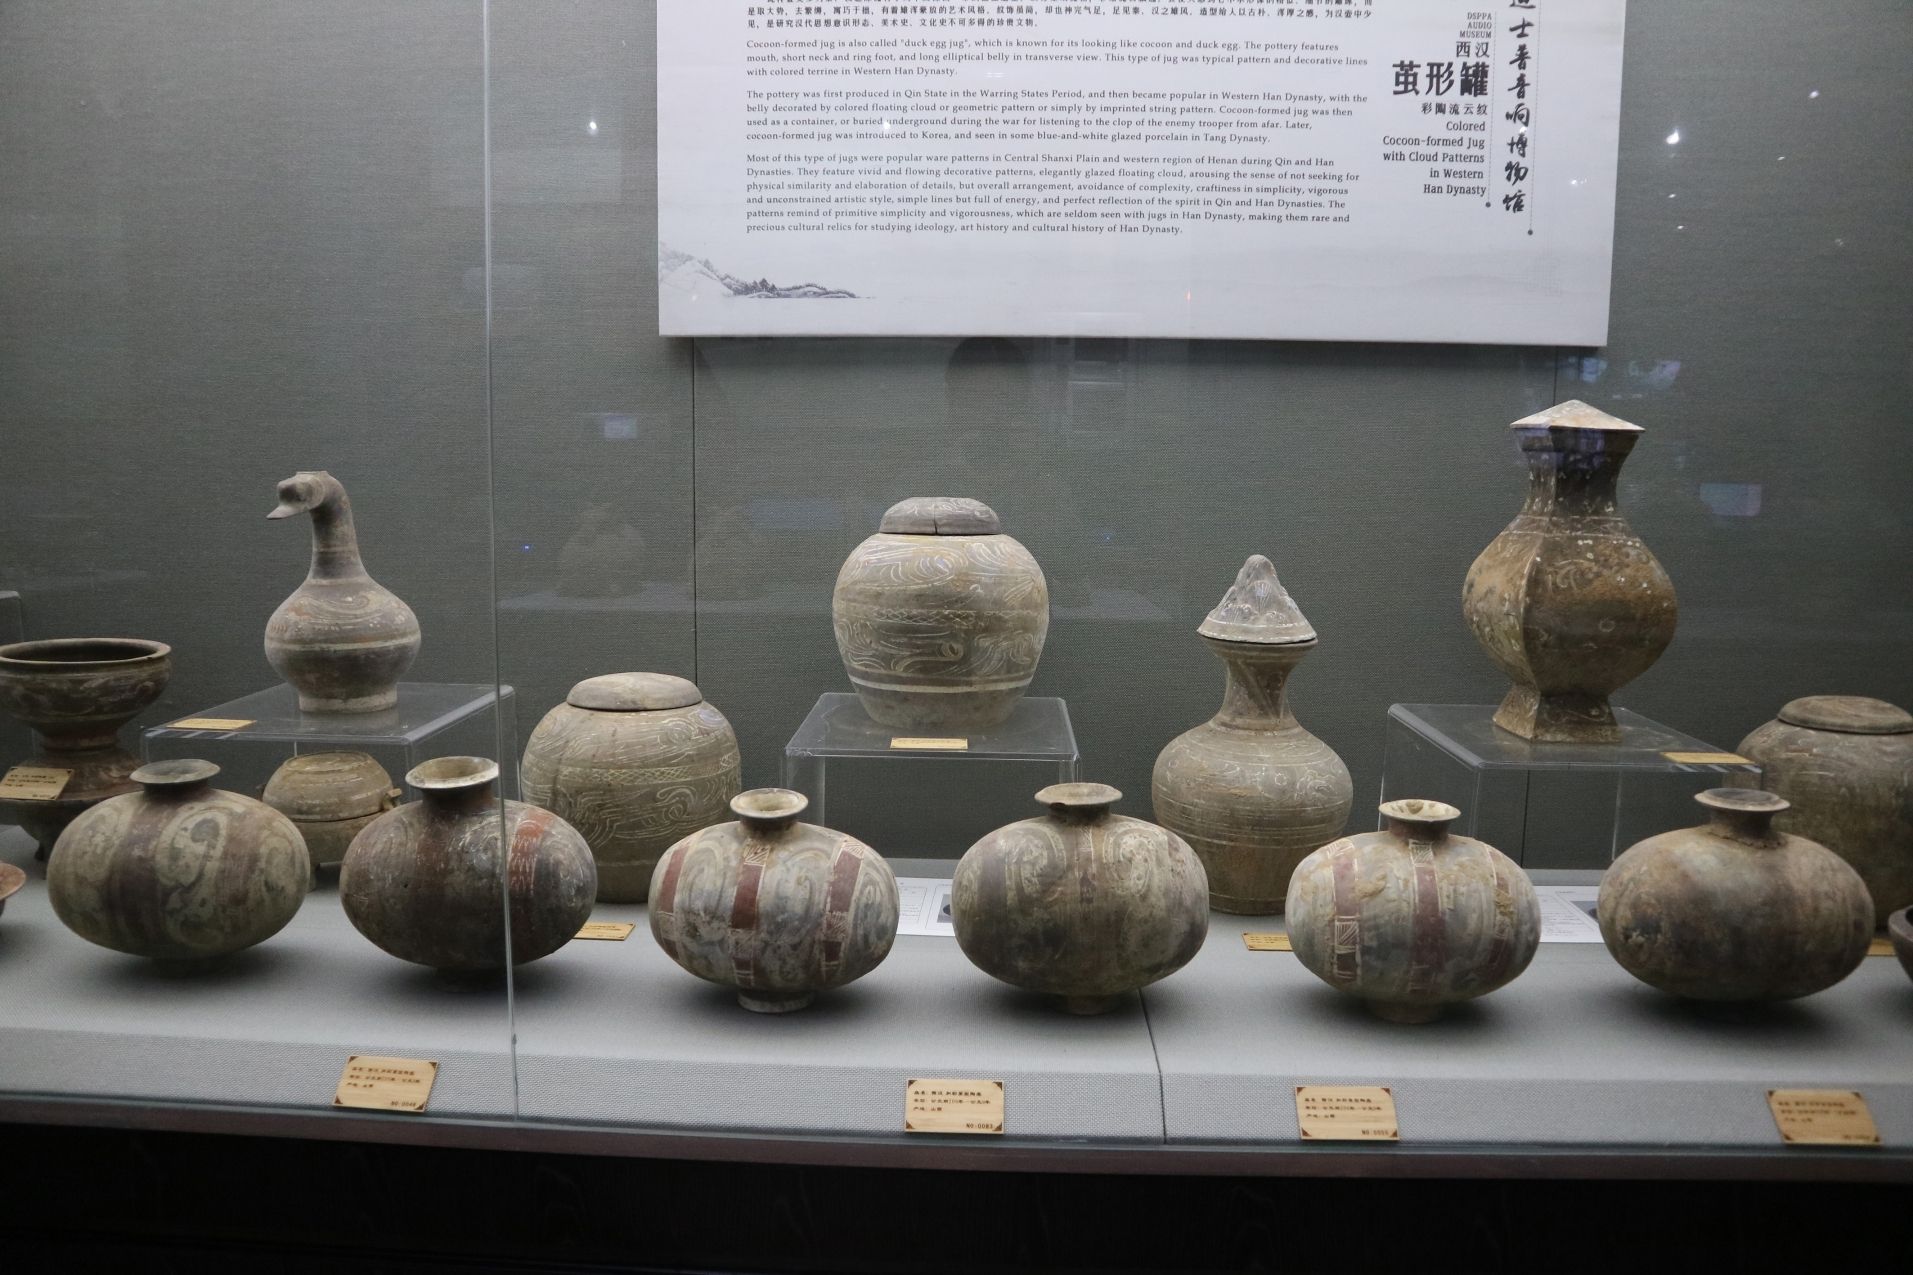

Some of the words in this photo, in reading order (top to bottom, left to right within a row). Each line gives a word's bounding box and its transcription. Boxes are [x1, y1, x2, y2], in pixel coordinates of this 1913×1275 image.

[1467, 12, 1492, 20] DSPPA
[1467, 22, 1492, 30] AUDIO
[746, 39, 817, 48] Cocoon-formed
[820, 39, 835, 50] jug
[838, 39, 846, 48] is
[848, 39, 867, 48] also
[870, 39, 897, 47] called
[930, 40, 946, 49] egg
[974, 39, 1002, 47] which
[1005, 39, 1013, 47] is
[1016, 39, 1047, 48] known
[1050, 39, 1064, 48] for
[1067, 39, 1078, 48] its
[1082, 39, 1116, 50] looking
[1120, 39, 1137, 48] like
[1176, 40, 1192, 49] and
[1196, 40, 1218, 50] duck
[1245, 41, 1261, 50] The
[1264, 41, 1297, 53] pottery
[1301, 42, 1338, 51] features
[1456, 40, 1490, 58] 西汉
[782, 53, 805, 61] short
[808, 52, 830, 61] neck
[832, 52, 850, 61] and
[853, 52, 872, 63] ring
[899, 52, 916, 61] and
[919, 52, 940, 63] long
[942, 52, 984, 63] elliptical
[987, 52, 1009, 63] belly
[1013, 52, 1022, 61] in
[1025, 52, 1073, 62] transverse
[1106, 53, 1124, 62] This
[1128, 53, 1148, 64] type
[1151, 54, 1160, 62] of
[1163, 54, 1178, 65] jug
[1202, 54, 1234, 65] typical
[1237, 55, 1270, 66] pattern
[1274, 55, 1290, 64] and
[1294, 56, 1342, 65] decorative
[1346, 56, 1367, 66] lines
[747, 67, 767, 76] with
[770, 67, 804, 76] colored
[808, 66, 838, 75] terrine
[841, 66, 850, 75] in
[854, 66, 891, 75] Western
[894, 66, 914, 75] Han
[1392, 60, 1490, 97] 茧形罐
[746, 104, 768, 114] belly
[772, 103, 817, 112] decorated
[820, 103, 831, 114] by
[834, 103, 868, 112] colored
[872, 103, 908, 114] floating
[910, 103, 936, 112] cloud
[952, 103, 998, 114] geometric
[1001, 103, 1034, 114] pattern
[1051, 103, 1082, 114] simply
[1085, 104, 1096, 114] by
[1100, 104, 1146, 115] imprinted
[1149, 104, 1176, 115] string
[1219, 105, 1291, 115] Cocoon-formed
[1294, 106, 1308, 117] jug
[1312, 108, 1329, 116] was
[1332, 107, 1352, 116] then
[1421, 102, 1488, 116] 彩陶流云纹
[1446, 121, 1486, 132] Colored
[746, 131, 814, 140] cocoon-formed
[817, 131, 832, 142] jug
[856, 131, 906, 140] introduced
[910, 131, 918, 140] to
[954, 131, 972, 140] and
[998, 131, 1007, 140] in
[1037, 131, 1108, 140] blue-and-white
[1111, 132, 1142, 143] glazed
[1145, 132, 1188, 143] porcelain
[1191, 133, 1200, 142] in
[1204, 133, 1226, 144] Tang
[1383, 136, 1463, 147] Cocoon-formed
[1467, 137, 1485, 150] Jug
[1383, 152, 1406, 162] with
[1409, 152, 1438, 162] Cloud
[1442, 153, 1485, 163] Patterns
[798, 167, 818, 178] They
[822, 167, 854, 176] feature
[858, 167, 882, 176] vivid
[885, 167, 902, 176] and
[905, 167, 940, 178] flowing
[944, 167, 992, 176] decorative
[1039, 167, 1081, 178] elegantly
[1084, 167, 1115, 179] glazed
[1118, 168, 1154, 179] floating
[1189, 169, 1230, 180] arousing
[1233, 169, 1247, 178] the
[1250, 171, 1275, 179] sense
[1278, 170, 1287, 179] of
[1290, 170, 1305, 179] not
[1308, 171, 1343, 182] seeking
[1346, 171, 1358, 180] for
[1429, 168, 1440, 178] in
[1443, 169, 1484, 179] Western
[746, 181, 784, 192] physical
[788, 181, 830, 192] similarity
[835, 181, 852, 190] and
[854, 181, 906, 190] elaboration
[910, 181, 919, 190] of
[959, 181, 974, 190] but
[977, 181, 1010, 190] overall
[1077, 181, 1124, 191] avoidance
[1127, 182, 1136, 191] of
[1196, 183, 1240, 192] craftiness
[1244, 184, 1252, 192] in
[1308, 185, 1348, 196] vigorous
[1423, 184, 1443, 194] Han
[1446, 185, 1487, 197] Dynasty
[746, 223, 785, 234] precious
[788, 223, 824, 232] cultural
[827, 222, 851, 231] relics
[854, 222, 867, 231] for
[871, 222, 912, 233] studying
[960, 222, 973, 231] art
[976, 222, 1008, 233] history
[1012, 222, 1029, 231] and
[1032, 223, 1068, 232] cultural
[1072, 223, 1104, 234] history
[1107, 223, 1116, 232] of
[1120, 223, 1138, 232] Han
